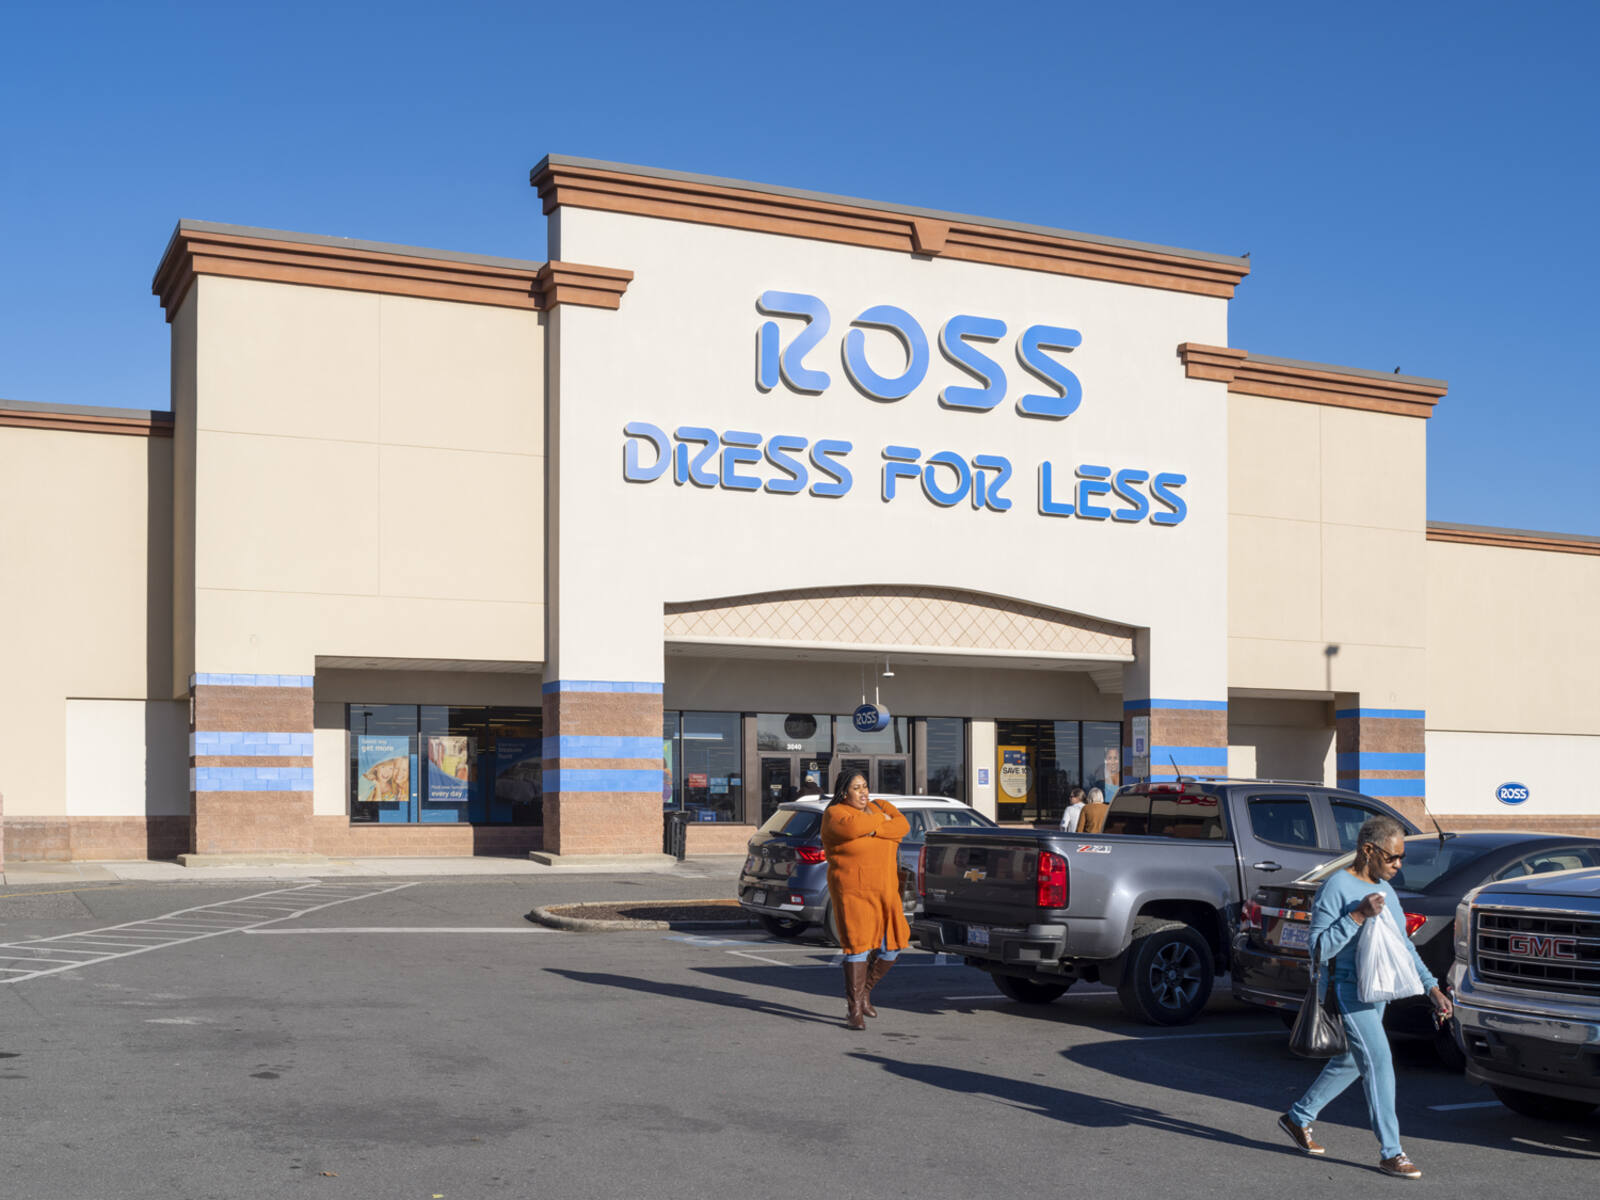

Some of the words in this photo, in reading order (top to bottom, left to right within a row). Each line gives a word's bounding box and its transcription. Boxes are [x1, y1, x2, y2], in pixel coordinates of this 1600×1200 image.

[757, 290, 1083, 420] ROSS
[623, 421, 853, 498] DRESS
[882, 445, 1013, 511] FOR
[1038, 461, 1188, 527] LESS
[856, 711, 877, 725] ROSS
[450, 790, 463, 798] day
[1500, 788, 1527, 799] ROSS
[1509, 934, 1577, 960] GMC
